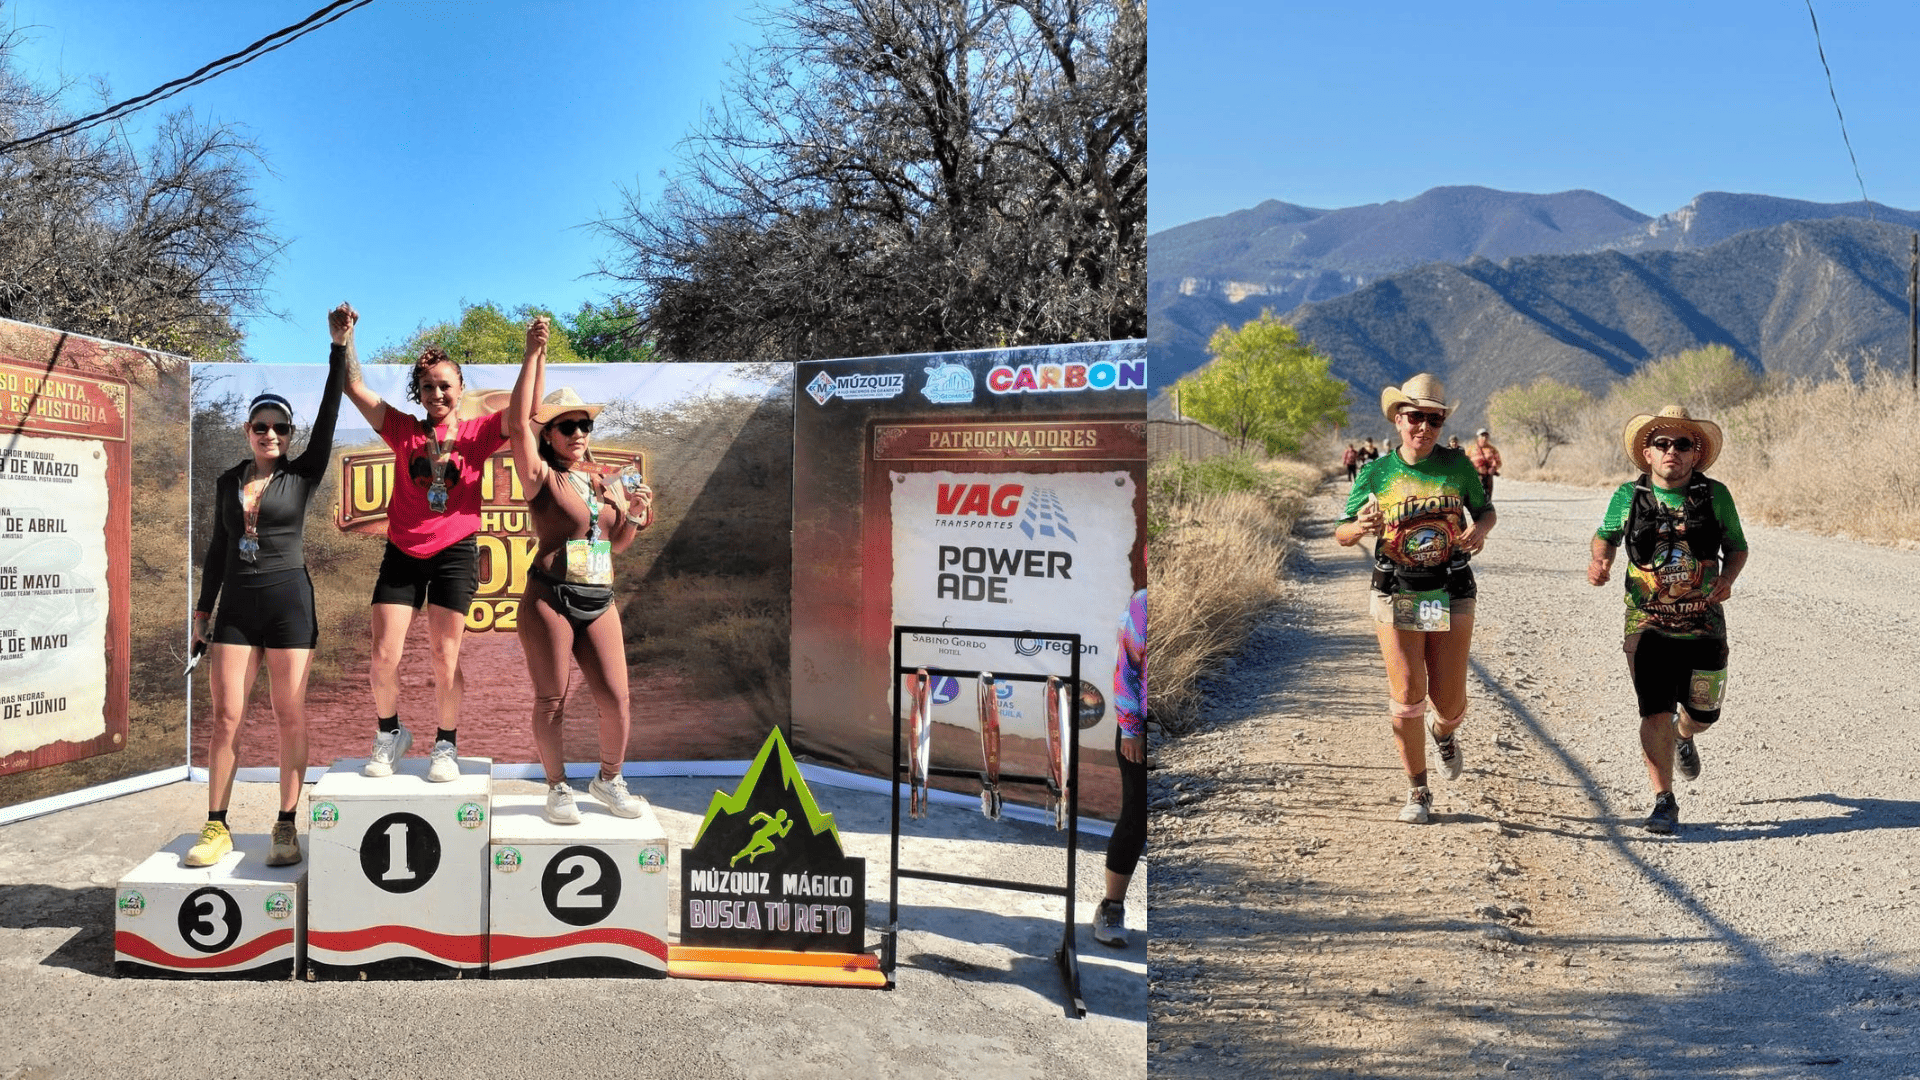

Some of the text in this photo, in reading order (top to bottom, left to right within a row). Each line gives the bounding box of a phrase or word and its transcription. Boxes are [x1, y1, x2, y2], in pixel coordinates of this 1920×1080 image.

[838, 376, 901, 389] MÚZQUIZ
[989, 362, 1145, 391] CARBON
[25, 377, 91, 404] CUENTA,
[11, 394, 107, 423] ES HISTORIA
[929, 430, 1097, 448] PATROCINADORES
[24, 450, 55, 460] MÚZQUIZ
[11, 459, 28, 474] DE
[33, 461, 78, 477] MARZO
[936, 484, 1024, 517] VAG
[6, 518, 68, 533] DE ABRIL
[935, 519, 1013, 529] TRANSPORTES
[939, 545, 1073, 580] POWER
[0, 574, 60, 590] DE MAYO
[1660, 571, 1689, 584] RETO
[1419, 600, 1443, 620] 69
[8, 638, 26, 653] DE
[31, 634, 68, 651] MAYO
[912, 633, 987, 649] SABINO GORDO
[1045, 641, 1098, 655] regon
[938, 648, 961, 656] HOTEL
[17, 692, 45, 702] NEGRAS
[4, 697, 67, 720] DE JUNIO
[382, 823, 416, 880] 1
[556, 855, 603, 908] 2
[690, 867, 853, 897] MÚZQUIZ MÁGICO
[189, 894, 229, 947] 3
[689, 899, 852, 935] BUSCA TÚ RETO
